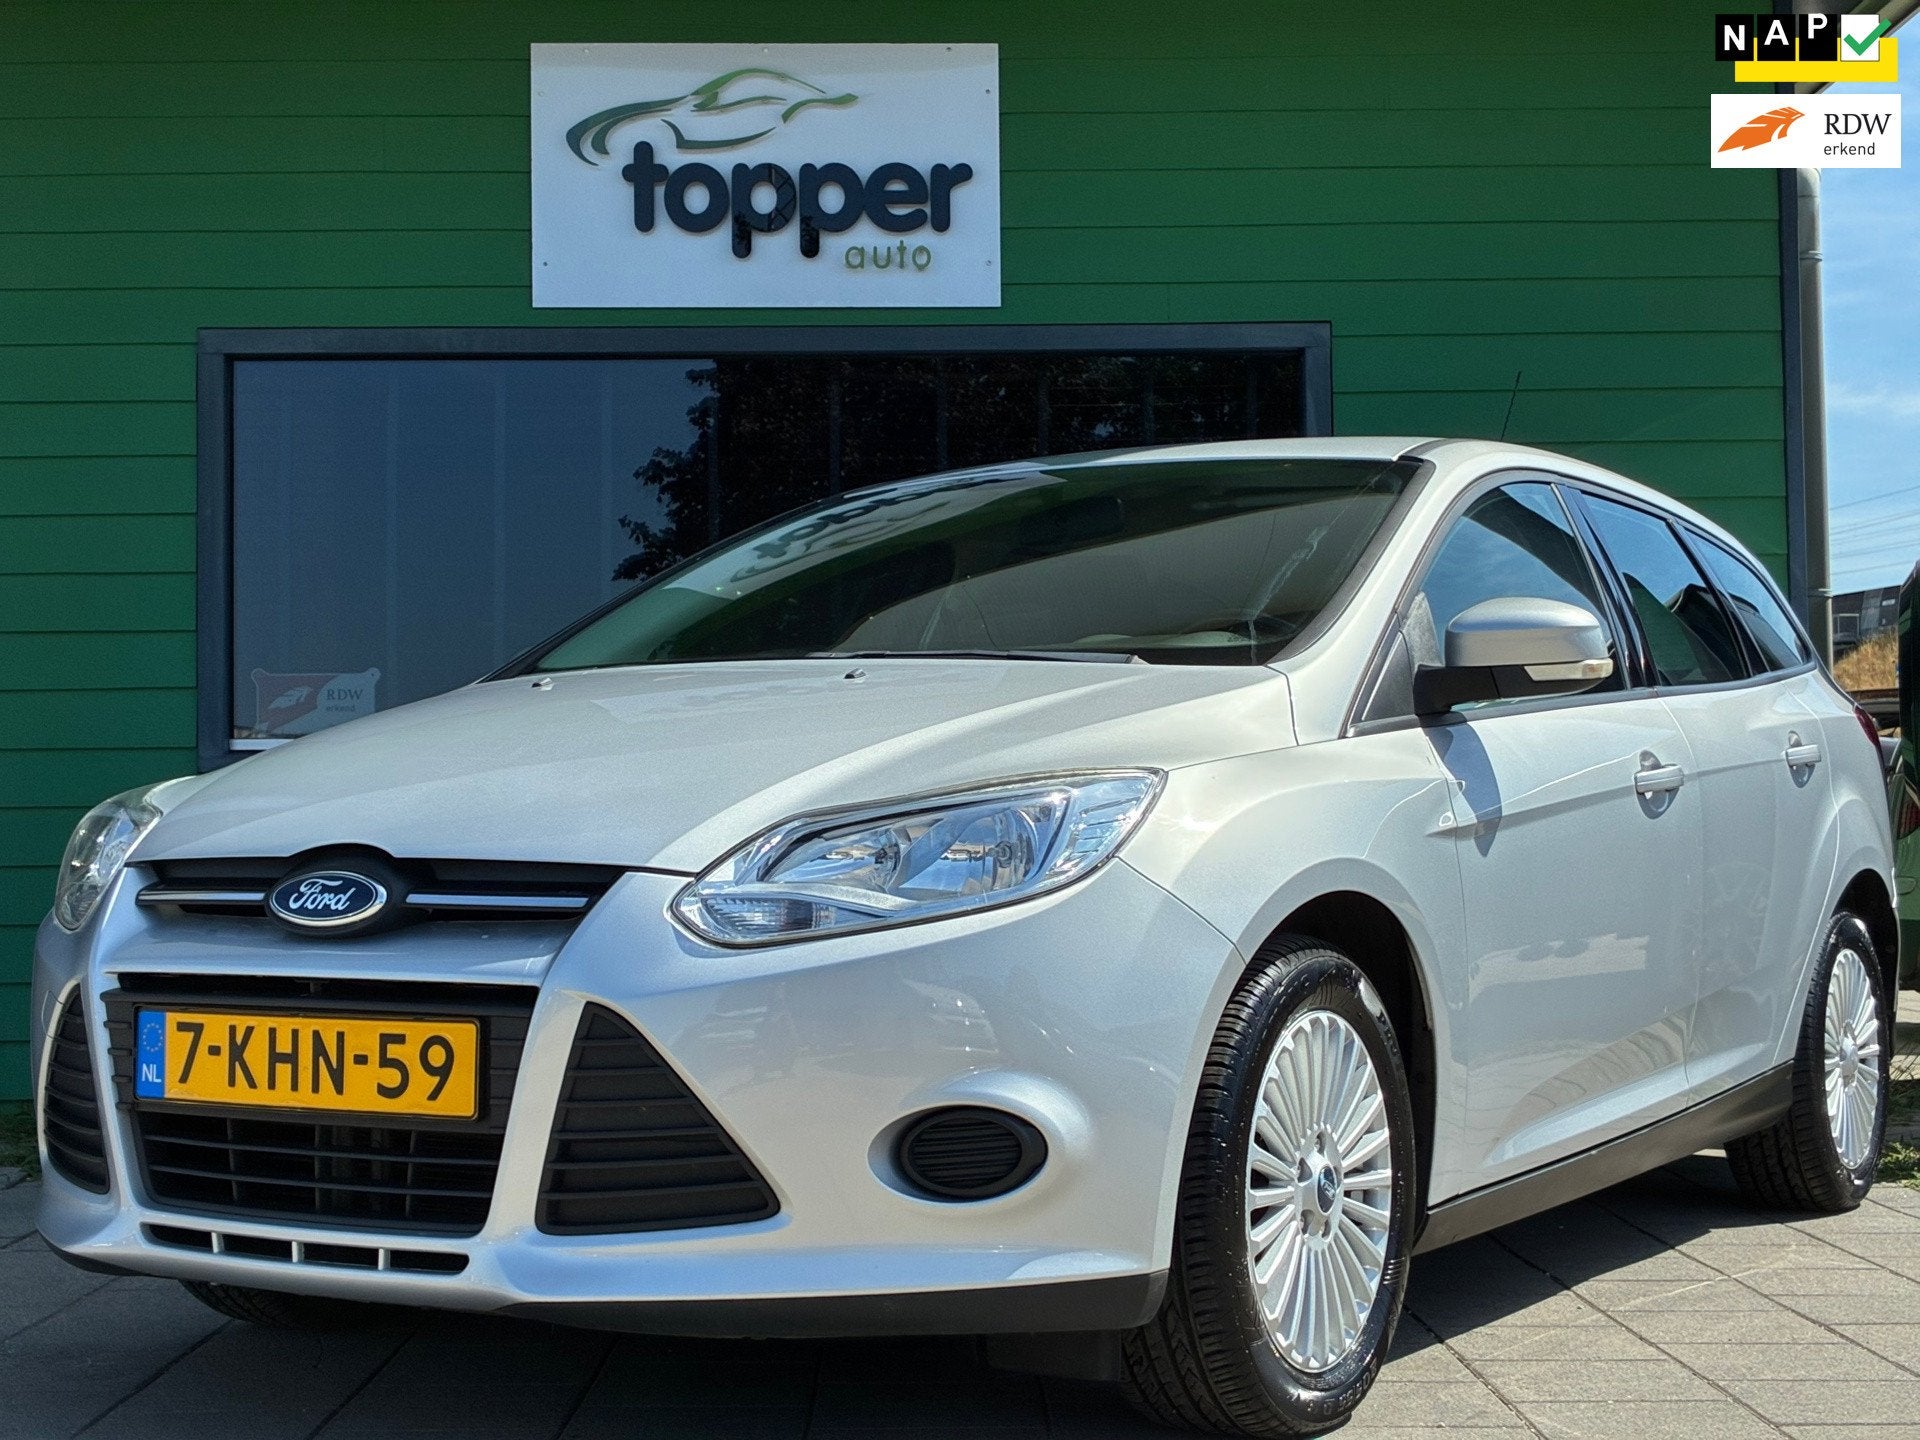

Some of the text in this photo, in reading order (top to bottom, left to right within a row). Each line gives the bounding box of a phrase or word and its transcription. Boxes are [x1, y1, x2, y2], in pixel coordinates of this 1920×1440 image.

[621, 140, 974, 259] topper
[844, 239, 932, 271] auto
[326, 688, 364, 701] RDW
[288, 878, 357, 911] Ford
[141, 1063, 163, 1084] NL
[175, 1020, 456, 1102] 7-KHN-59
